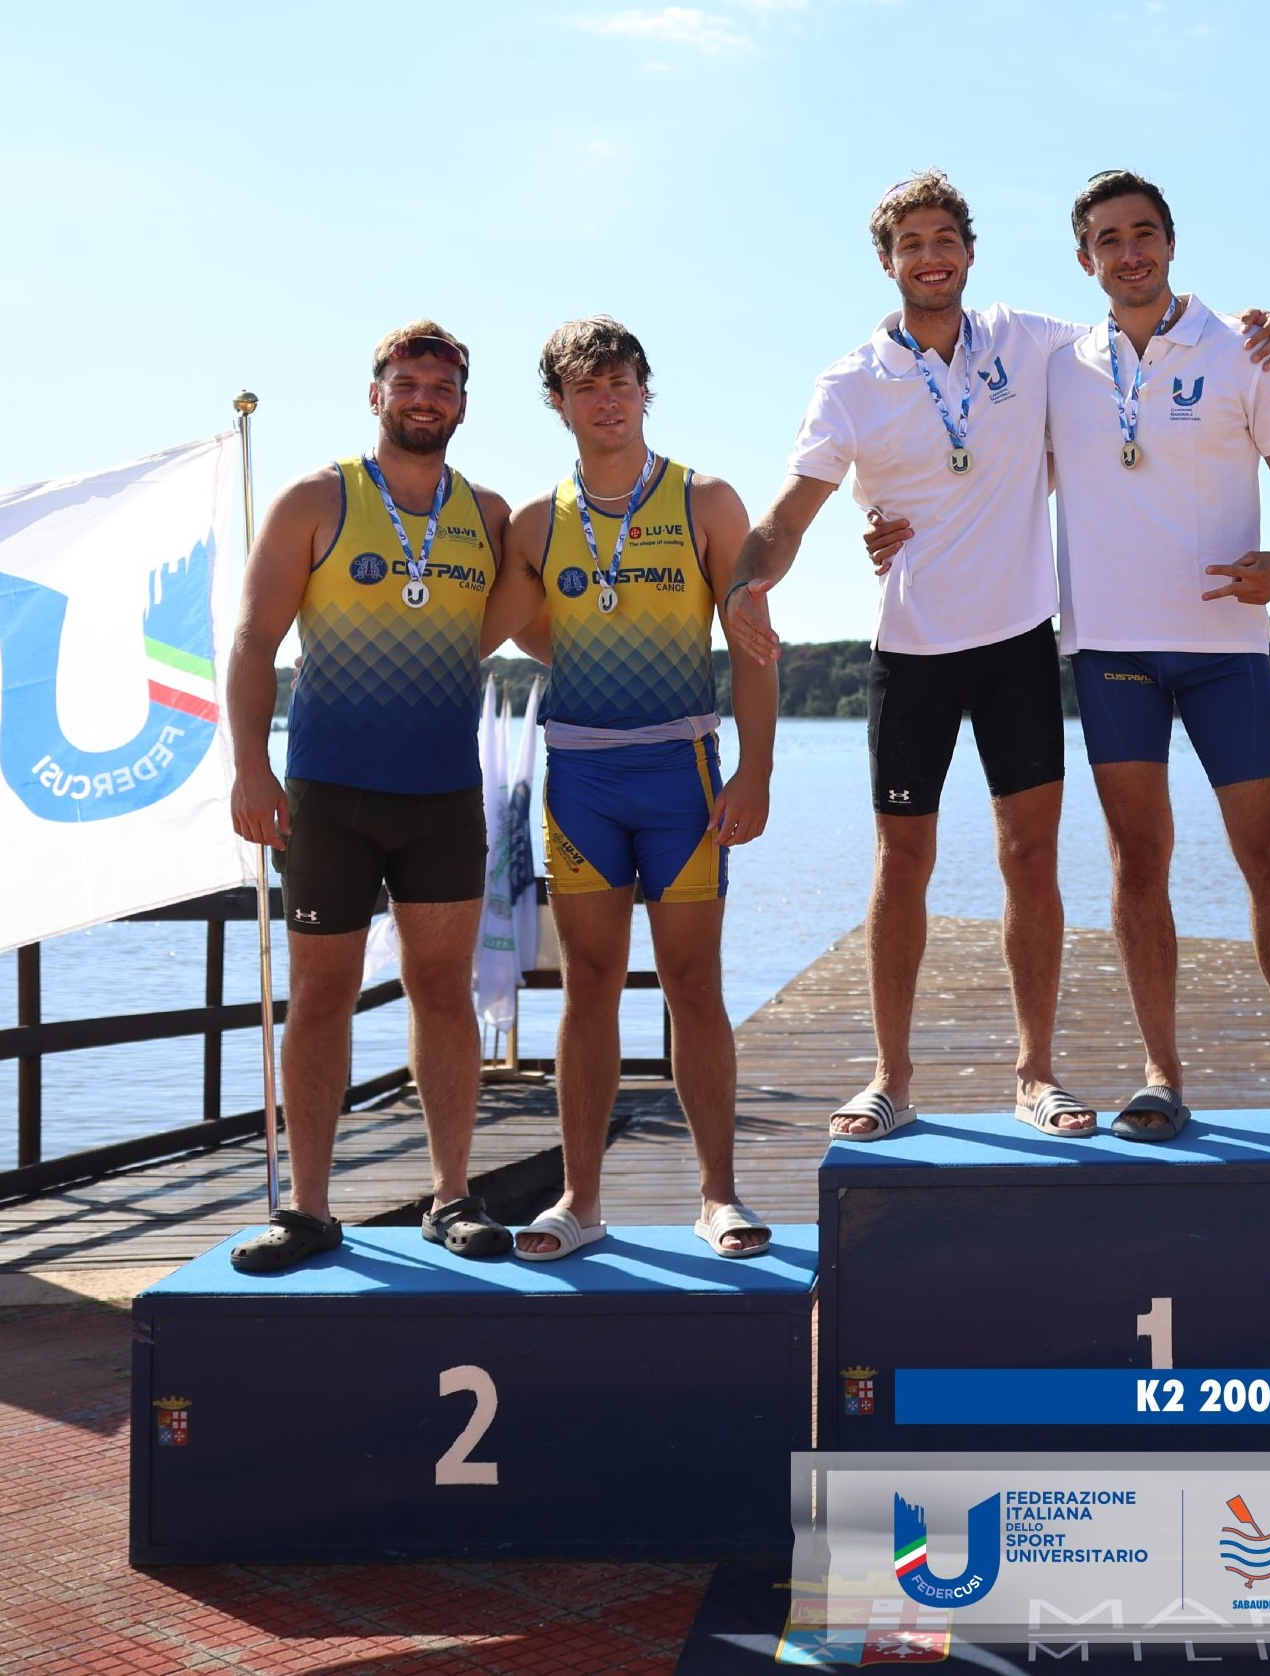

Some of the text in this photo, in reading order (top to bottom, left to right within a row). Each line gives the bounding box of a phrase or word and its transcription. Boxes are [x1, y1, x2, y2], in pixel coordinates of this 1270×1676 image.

[656, 583, 685, 592] CANOE
[1137, 1297, 1173, 1369] 1
[435, 1364, 498, 1485] 2
